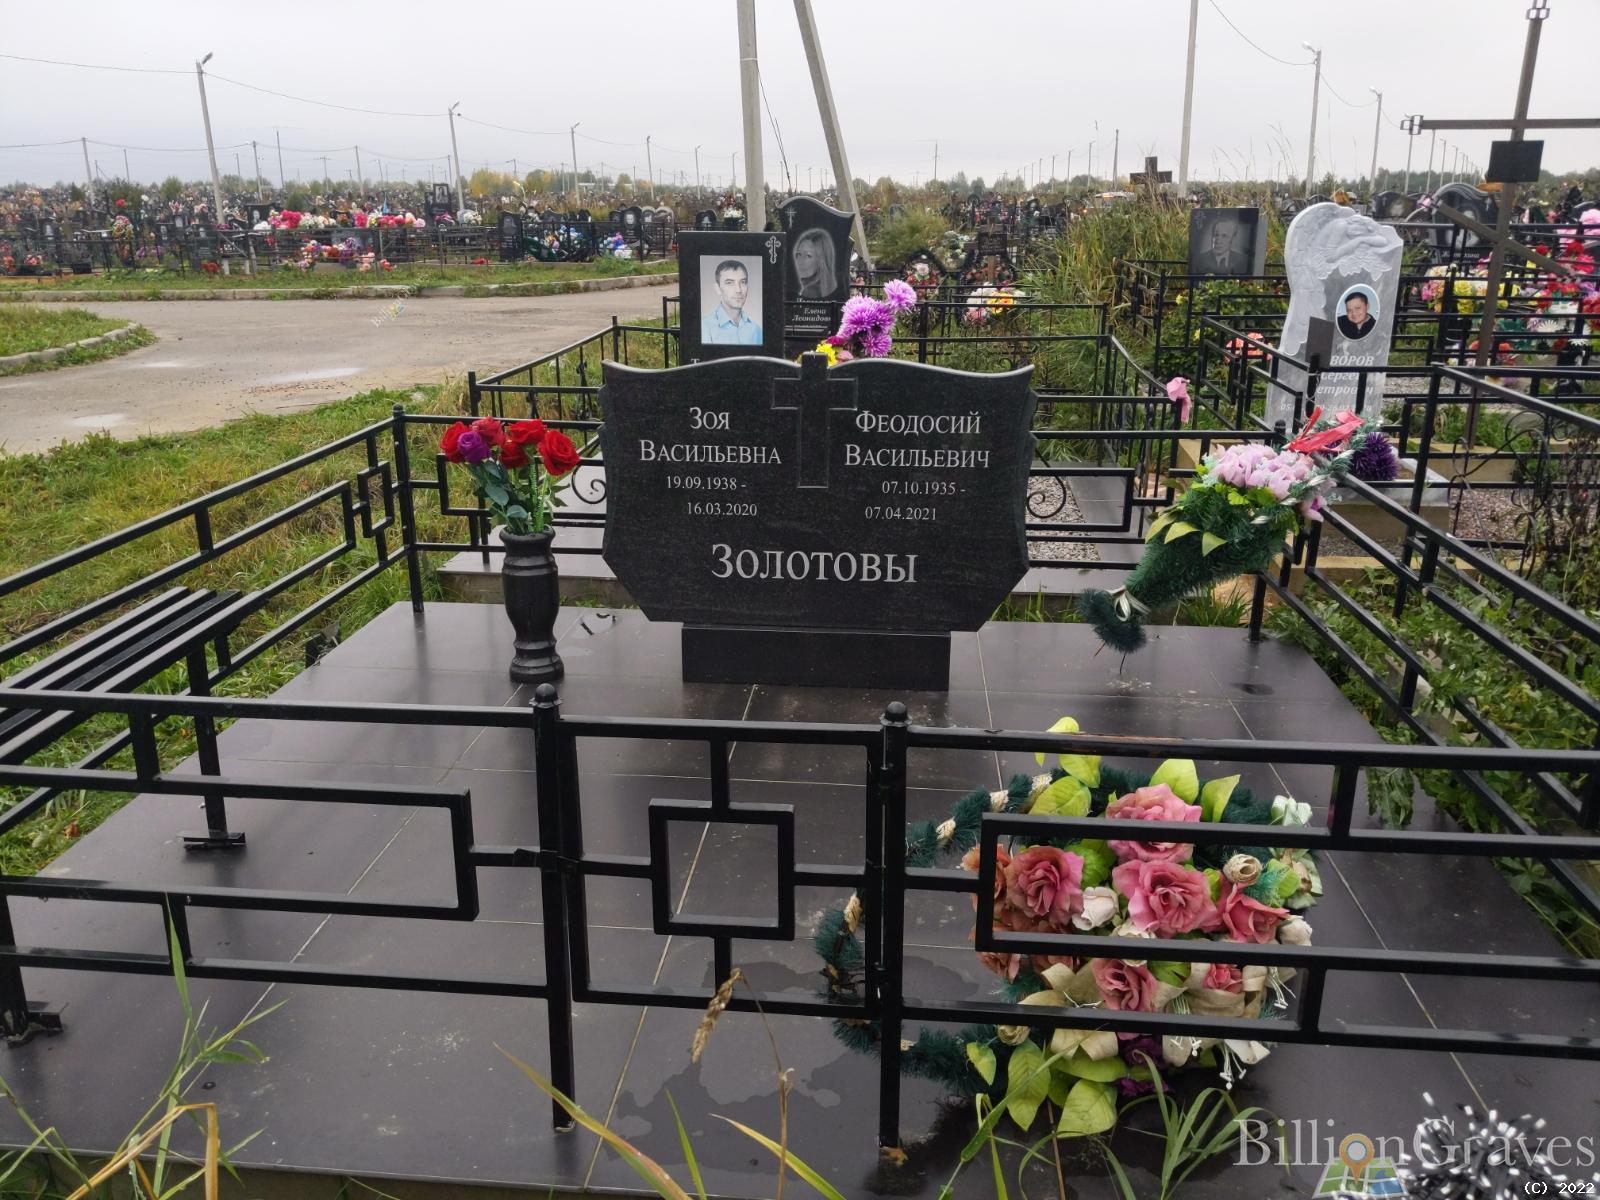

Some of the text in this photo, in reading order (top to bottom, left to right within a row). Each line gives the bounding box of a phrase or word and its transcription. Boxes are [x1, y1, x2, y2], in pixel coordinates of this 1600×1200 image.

[666, 475, 737, 490] 19.09.1938
[882, 480, 956, 496] 07.10.1935
[687, 502, 758, 517] 16.03.2020
[865, 506, 937, 521] 07.04.2021
